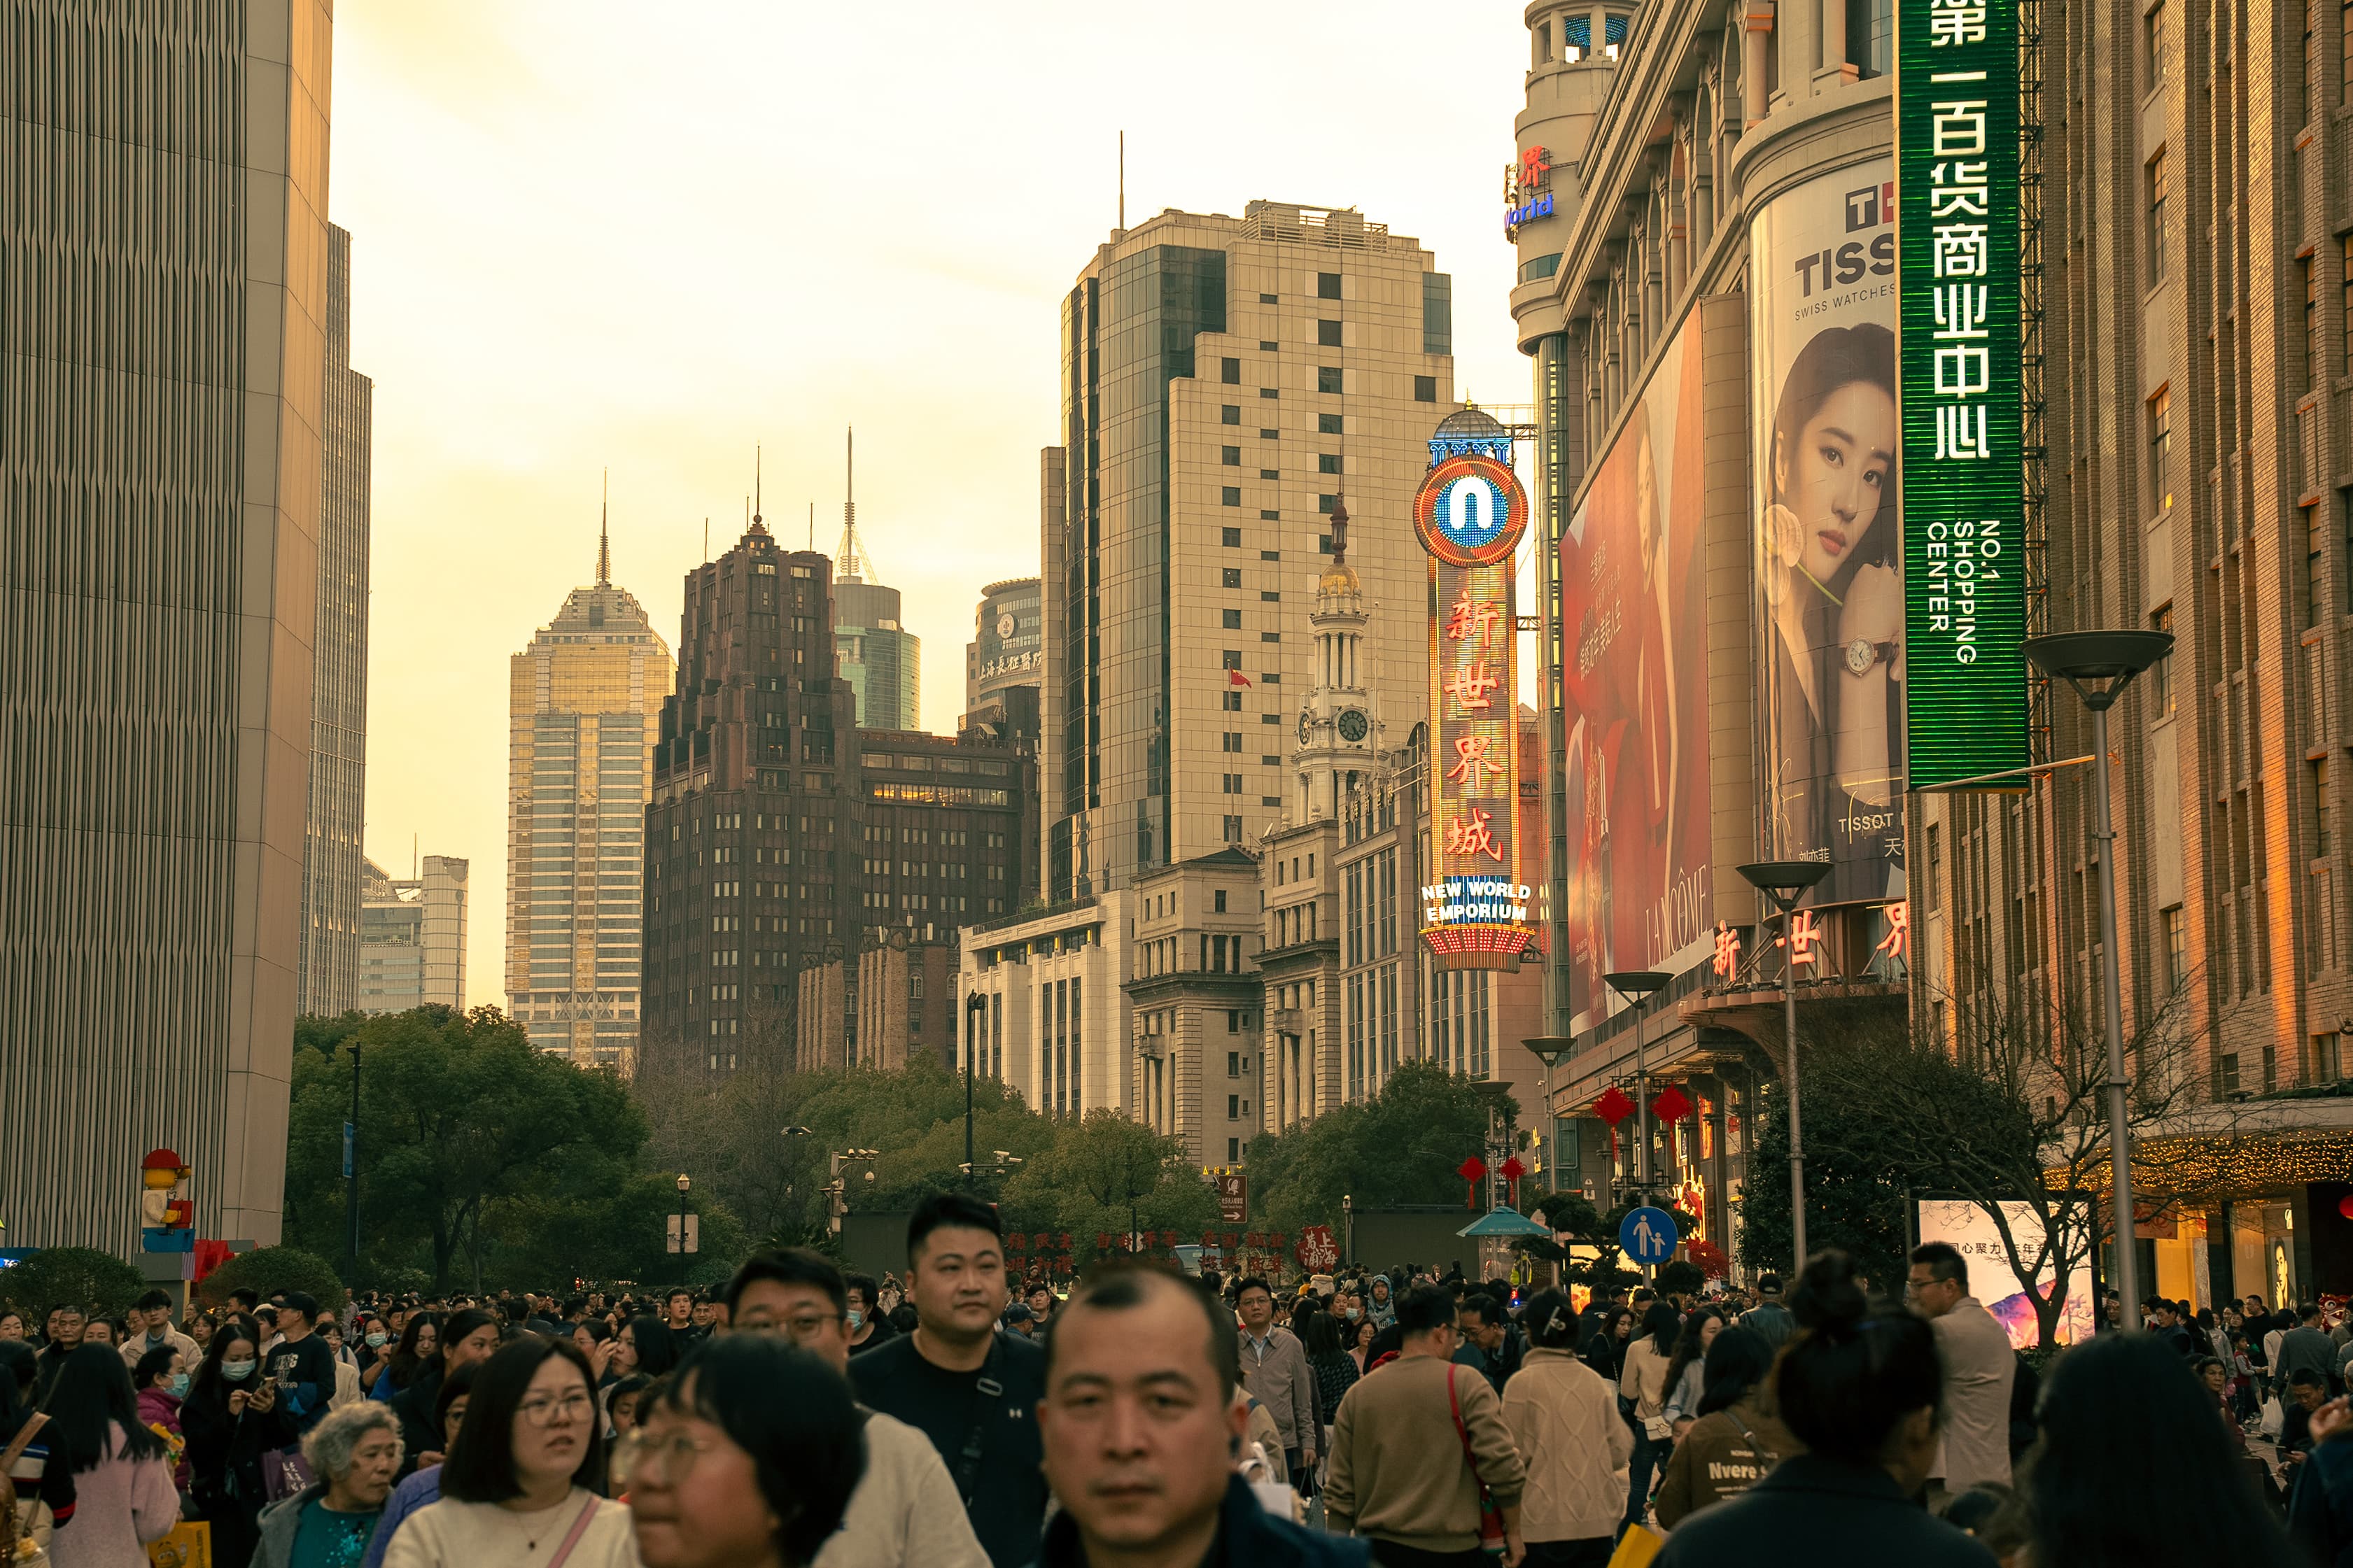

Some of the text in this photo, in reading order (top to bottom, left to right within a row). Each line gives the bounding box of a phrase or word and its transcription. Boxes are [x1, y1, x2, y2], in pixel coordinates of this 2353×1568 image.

[1931, 0, 1990, 460] 第一百货商业中心
[1794, 283, 1895, 321] SWISS WATCHES
[1980, 520, 2001, 580] NO.1
[1927, 521, 1949, 633] CENTER
[1953, 521, 1976, 665] SHOPPING
[1443, 590, 1505, 862] 新世界城
[1838, 812, 1894, 833] TISSOT
[1799, 847, 1829, 862] 刘亦菲
[1421, 881, 1531, 900] NEW WORLD
[1426, 903, 1527, 921] EMPORIUM
[1319, 1231, 1338, 1266] 上海
